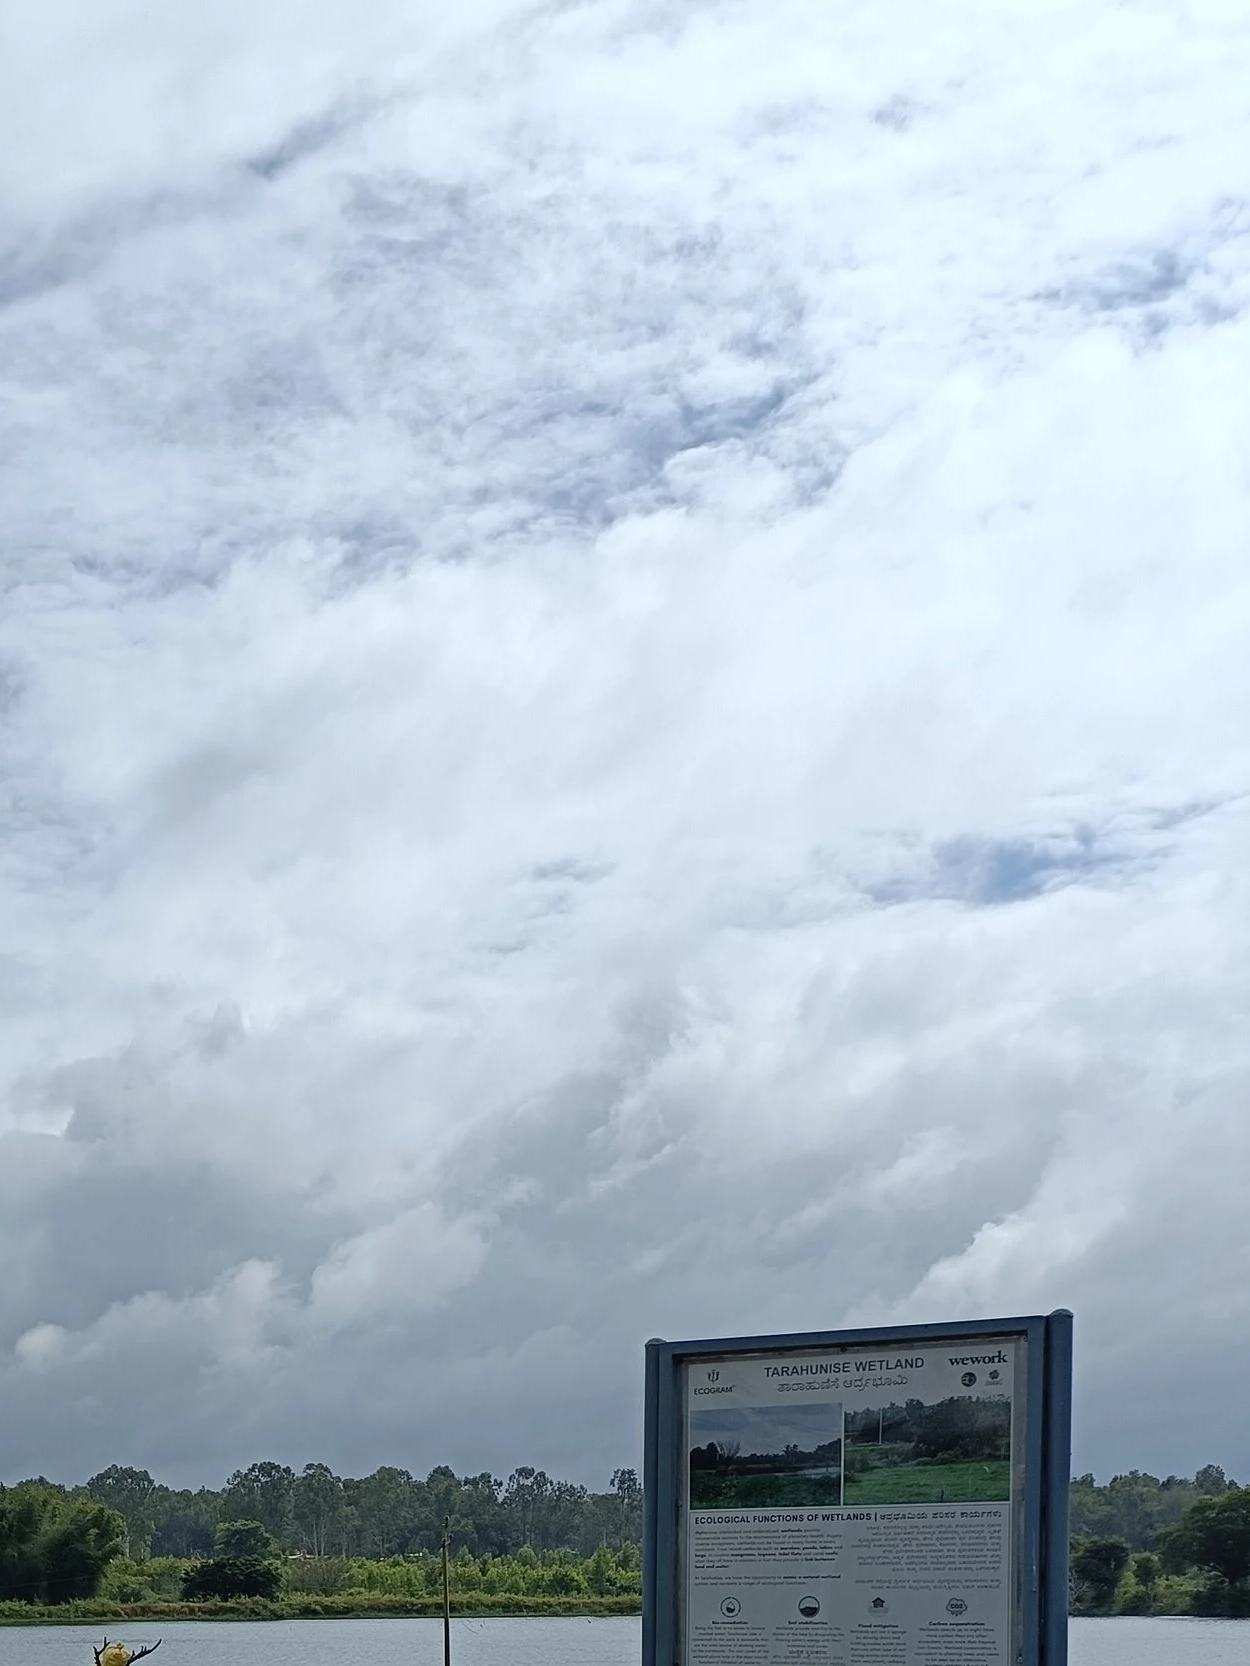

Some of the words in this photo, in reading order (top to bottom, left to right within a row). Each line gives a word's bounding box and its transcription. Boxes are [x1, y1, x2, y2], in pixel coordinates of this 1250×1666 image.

[948, 1350, 1008, 1366] wework
[764, 1362, 850, 1378] TARAHUNISE
[854, 1357, 924, 1372] WETLAND
[695, 1516, 750, 1524] ECOLOGICAL
[753, 1514, 804, 1523] FUNCTIONS
[807, 1514, 819, 1522] OF
[821, 1512, 872, 1522] WETLANDS
